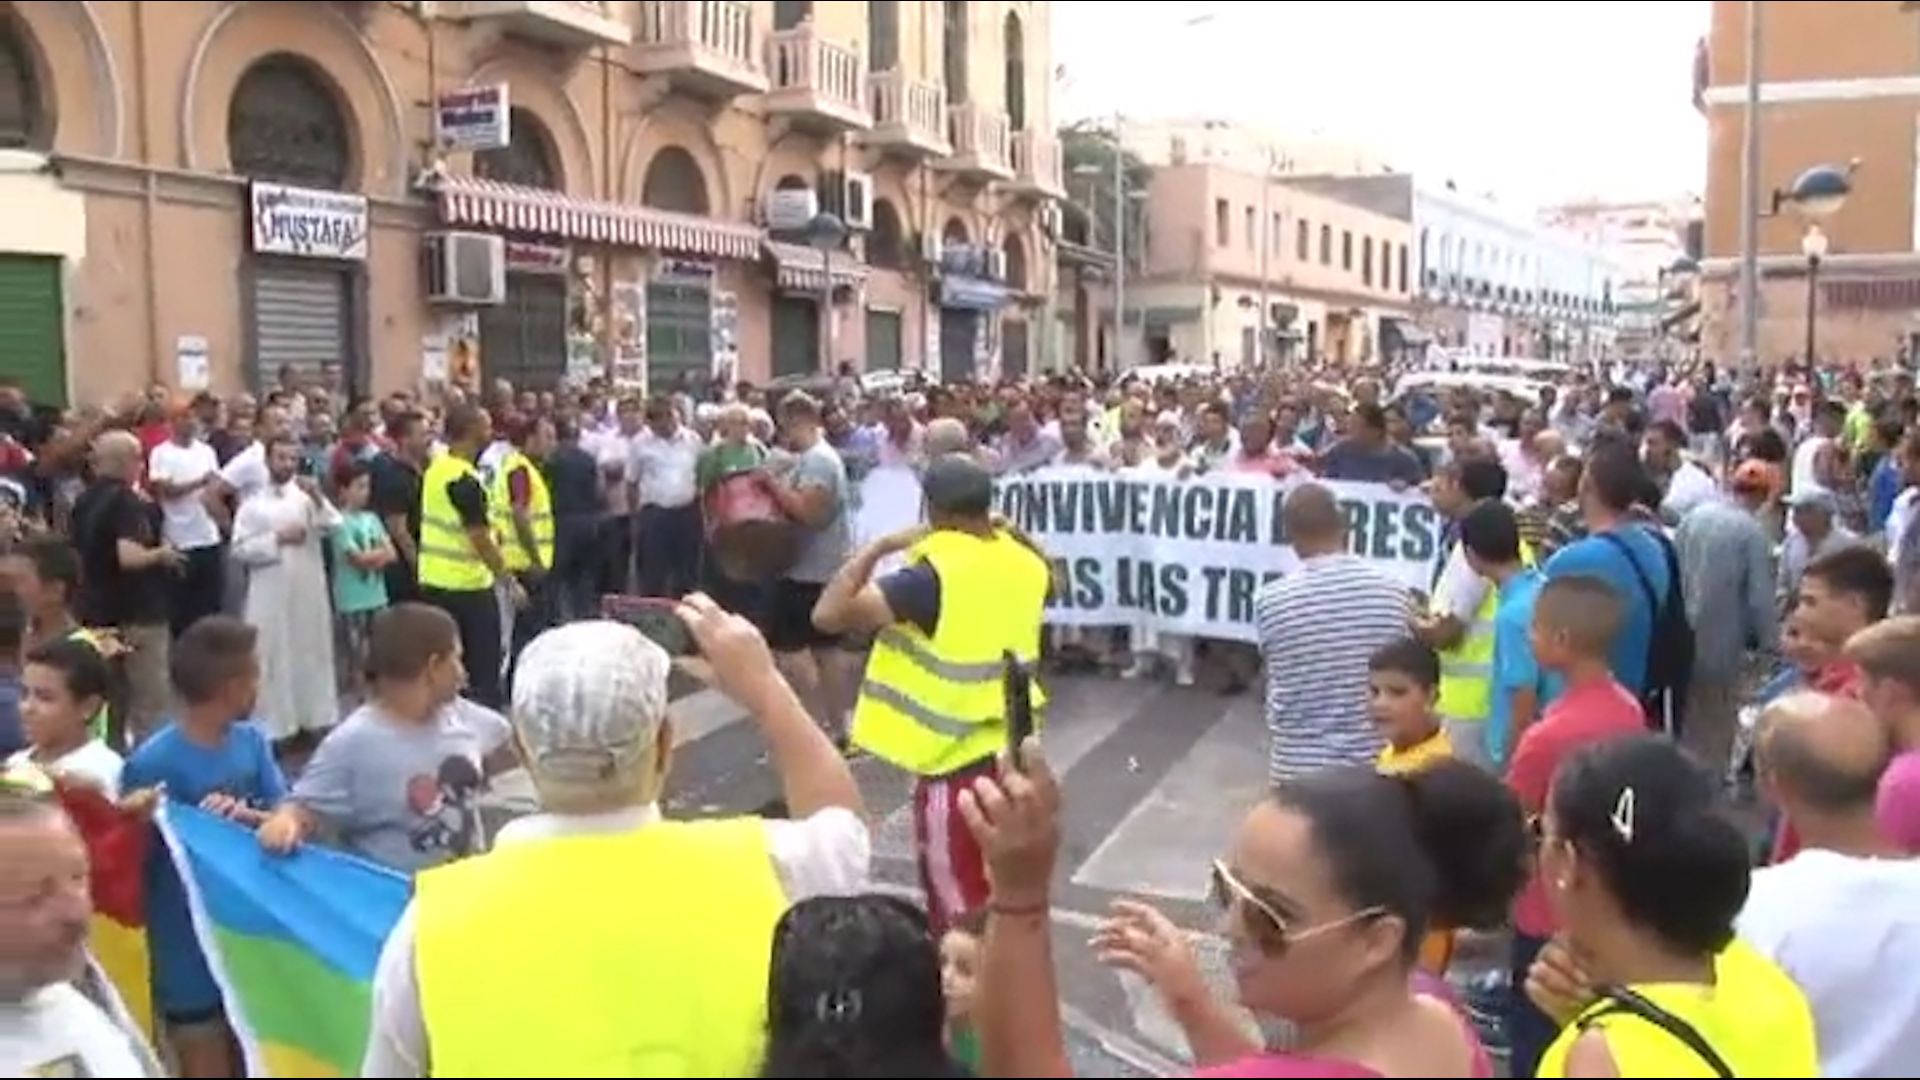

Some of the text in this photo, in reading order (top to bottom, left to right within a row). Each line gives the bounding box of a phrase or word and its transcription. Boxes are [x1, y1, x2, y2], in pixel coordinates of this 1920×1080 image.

[269, 211, 356, 247] MUSTAFA
[1046, 556, 1283, 623] AS LAS TR
